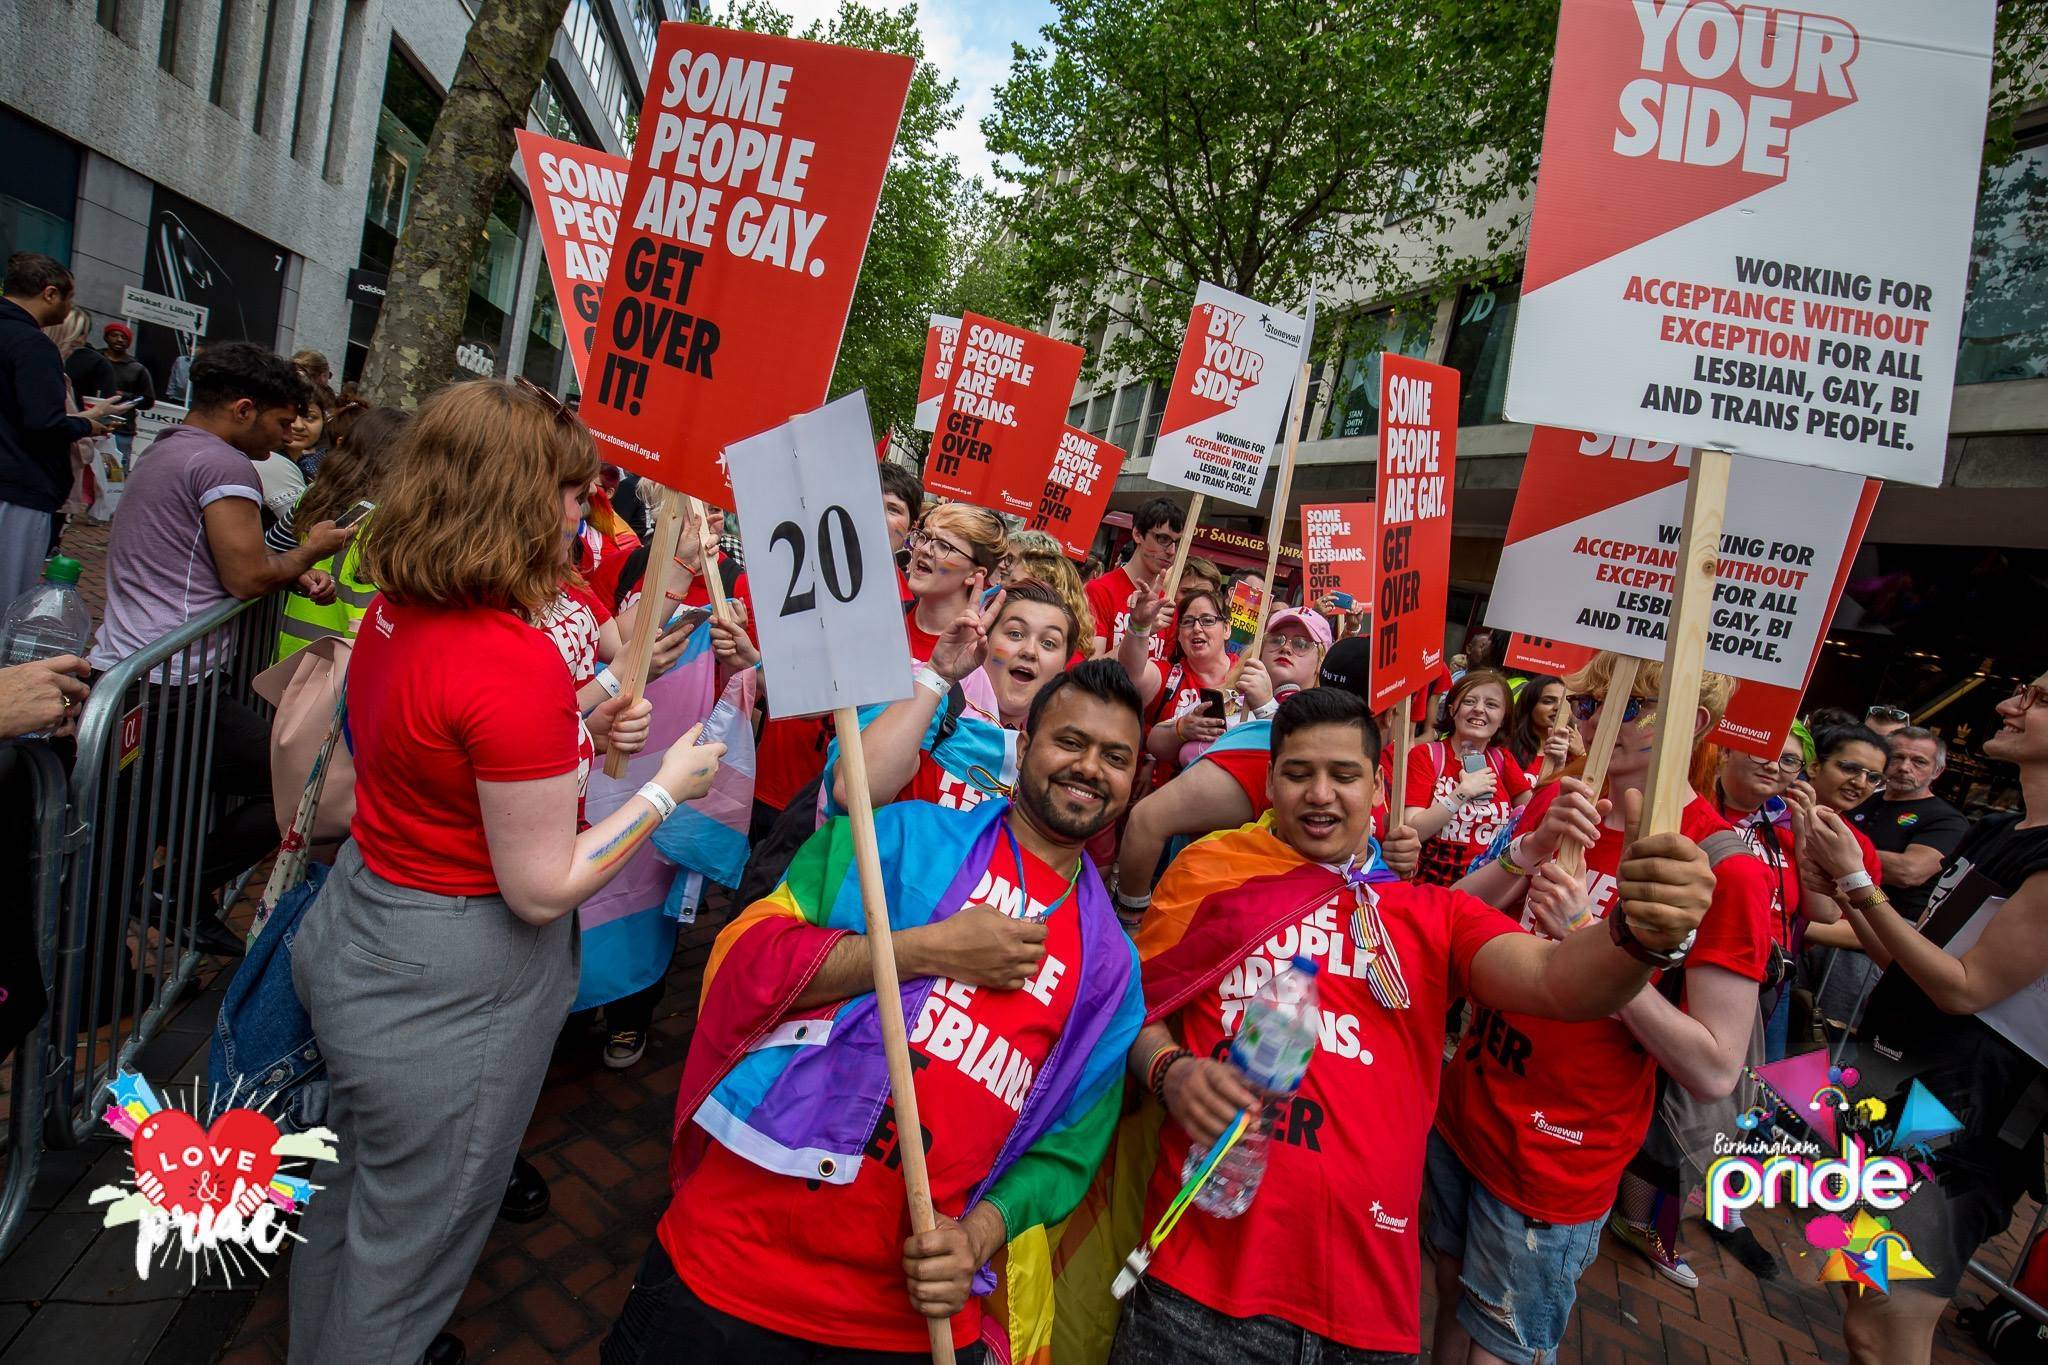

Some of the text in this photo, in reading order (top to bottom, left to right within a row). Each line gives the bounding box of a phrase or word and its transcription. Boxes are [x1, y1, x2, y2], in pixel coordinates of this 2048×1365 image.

[1631, 0, 1858, 99] YOUR
[661, 48, 794, 127] SOME
[1613, 78, 1792, 177] SIDE
[648, 113, 815, 202] PEOPLE
[549, 195, 620, 245] PEO
[633, 176, 827, 278] ARE GAY.
[274, 255, 283, 271] 7
[565, 240, 613, 283] AR
[625, 237, 704, 306] GET
[358, 284, 386, 296] adidas
[1735, 256, 1932, 313] WORKING FOR
[1623, 275, 1929, 347] ACCEPTANCE WITHOUT
[612, 296, 720, 380] OVER
[967, 325, 1025, 360] SOME
[1265, 323, 1301, 345] Stonewall
[1660, 315, 1922, 381] EXCEPTION FOR ALL
[961, 346, 1034, 386] PEOPLE
[1203, 336, 1264, 384] YOUR
[598, 353, 650, 416] IT!
[955, 369, 996, 398] ARE
[1190, 367, 1242, 408] SIDE
[1387, 374, 1432, 426] SOME
[1693, 355, 1919, 416] LESBIAN, GAY, BI
[947, 412, 984, 438] GET
[953, 389, 1018, 428] TRANS.
[1640, 383, 1914, 452] AND TRANS PEOPLE.
[941, 433, 992, 464] OVER
[1060, 432, 1098, 461] SOME
[1185, 435, 1263, 465] ACCEPTANCE WITHOUT
[1216, 432, 1266, 455] WORKING FOR
[1386, 427, 1440, 475] PEOPLE
[936, 452, 960, 476] IT!
[1053, 447, 1102, 481] PEOPLE
[1193, 449, 1258, 476] EXCEPTION FOR ALL
[1199, 463, 1256, 487] LESBIAN, GAY, BI
[1043, 481, 1069, 502] GET
[1047, 465, 1092, 496] ARE BI.
[1184, 471, 1252, 497] AND TRANS PEOPLE.
[1038, 498, 1072, 523] OVER
[1307, 509, 1341, 523] SOME
[1383, 475, 1446, 525] ARE GAY.
[1209, 528, 1264, 551] SAUSAGE
[1307, 522, 1351, 536] PEOPLE
[1308, 536, 1331, 549] ARE
[769, 504, 863, 618] 20
[1308, 548, 1366, 563] LESBIANS.
[1382, 526, 1412, 573] GET
[1573, 536, 1678, 569] ACCEPTAN
[1768, 541, 1815, 567] FOR
[1309, 563, 1330, 575] GET
[1309, 575, 1341, 588] OVER
[1381, 569, 1421, 621] OVER
[1713, 583, 1758, 608] FOR
[1759, 591, 1797, 616] ALL
[1576, 607, 1621, 631] AND
[1626, 616, 1669, 641] TRA
[1616, 591, 1793, 640] LESBI GAY, BI
[1379, 621, 1398, 670] IT!
[1719, 717, 1771, 741] Stonewall
[1441, 820, 1474, 844] RE
[1537, 1118, 1583, 1141] Stonewall
